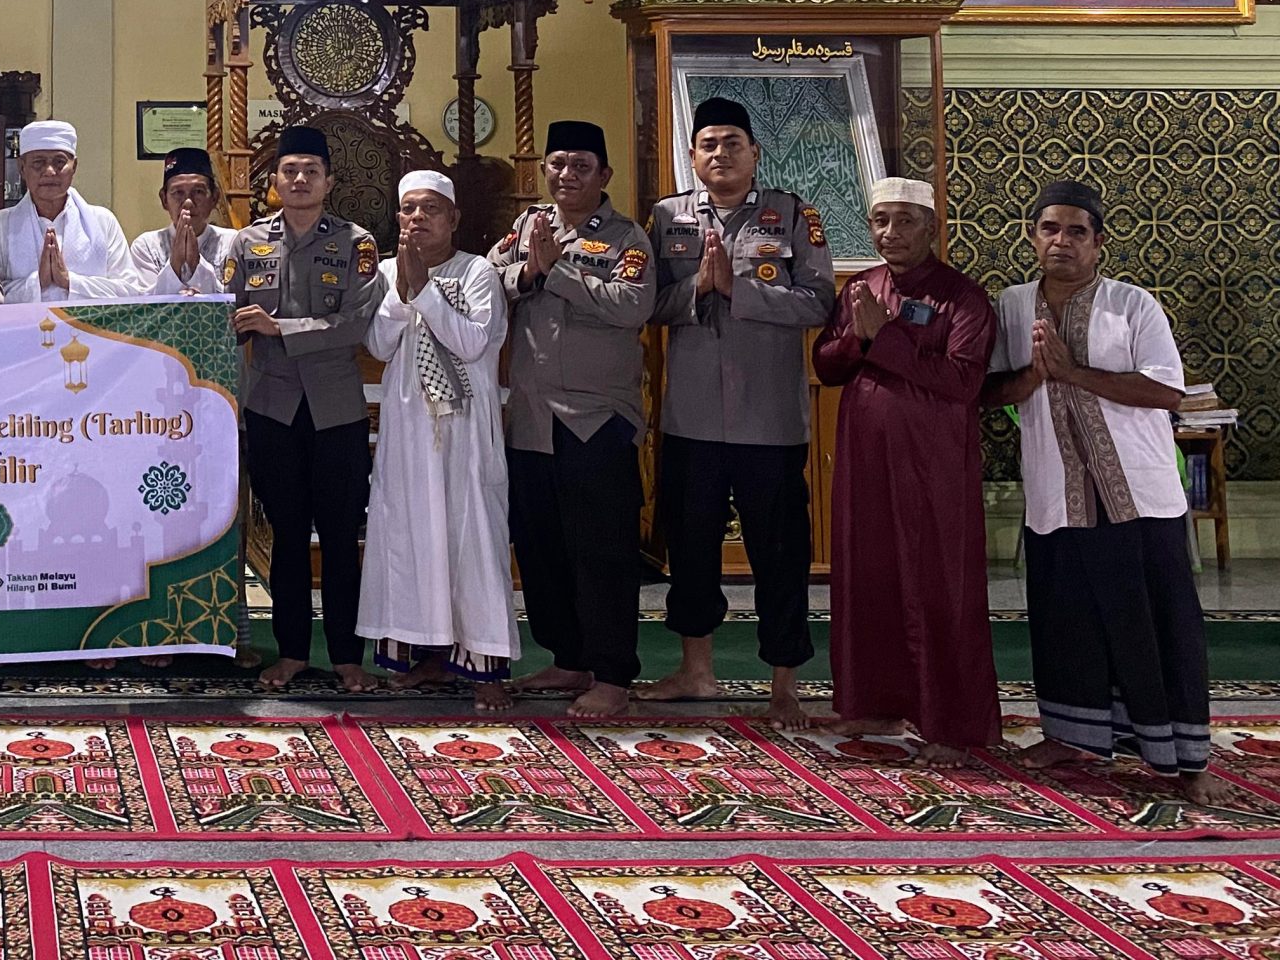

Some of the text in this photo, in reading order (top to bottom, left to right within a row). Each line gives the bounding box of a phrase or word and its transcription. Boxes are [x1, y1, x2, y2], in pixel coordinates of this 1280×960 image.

[750, 226, 787, 236] POLRI
[247, 259, 278, 270] BAYU
[313, 256, 348, 269] POLRI
[572, 253, 610, 269] POLRI
[80, 409, 194, 444] (Tarling)
[6, 571, 76, 583] Takkan Melayu
[6, 581, 78, 594] Hilang Di Bumi
